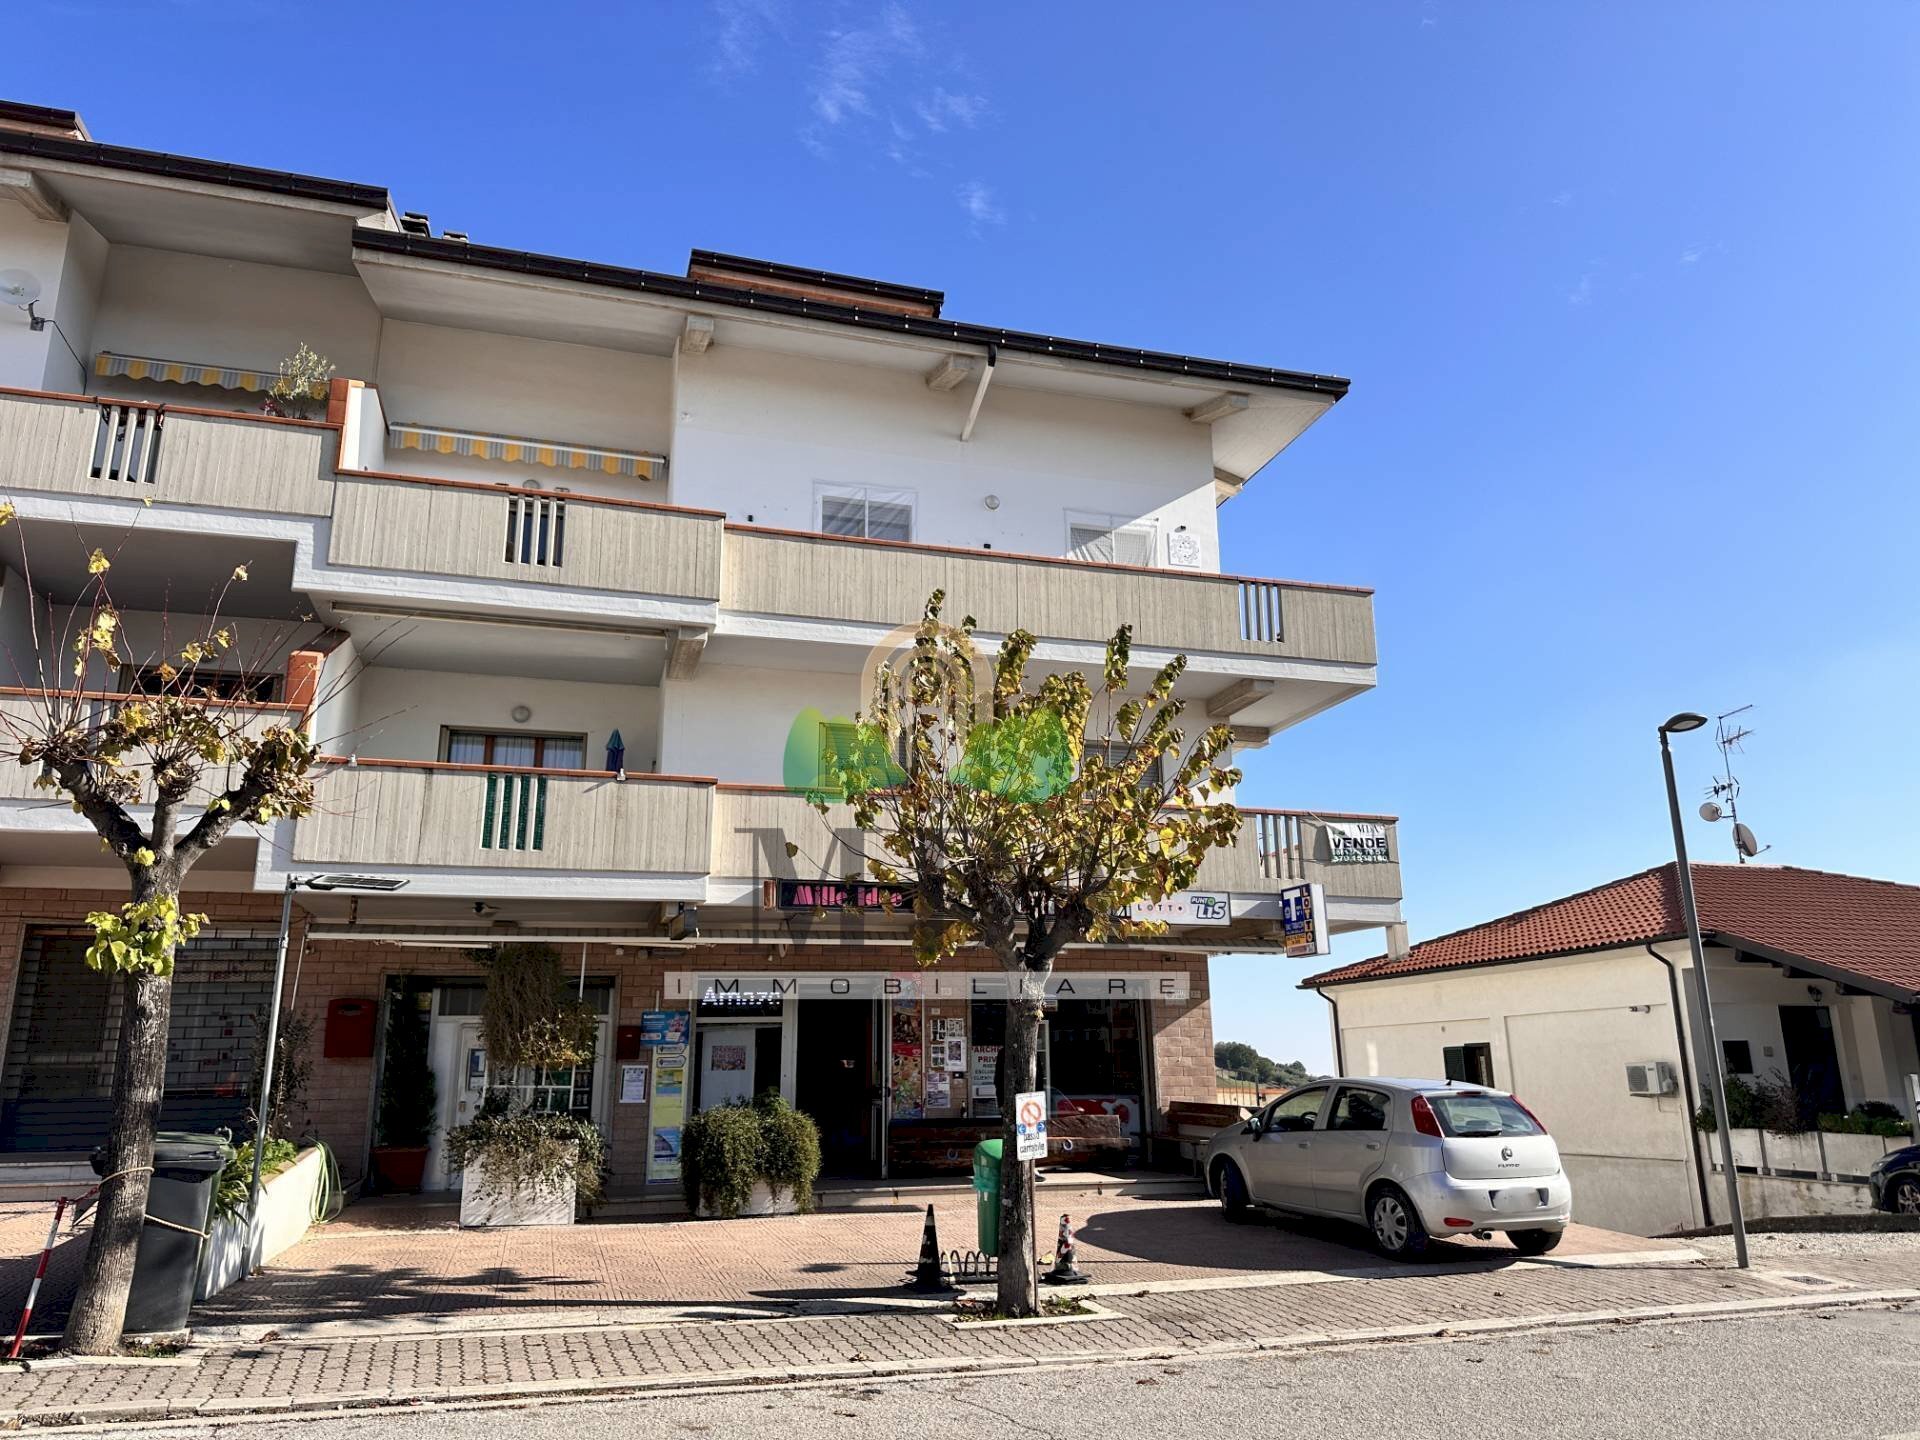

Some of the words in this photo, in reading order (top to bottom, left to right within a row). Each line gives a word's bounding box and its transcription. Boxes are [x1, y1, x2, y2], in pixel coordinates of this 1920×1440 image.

[1333, 837, 1386, 849] VENDE
[793, 884, 848, 906] Mille
[857, 886, 903, 908] Ide
